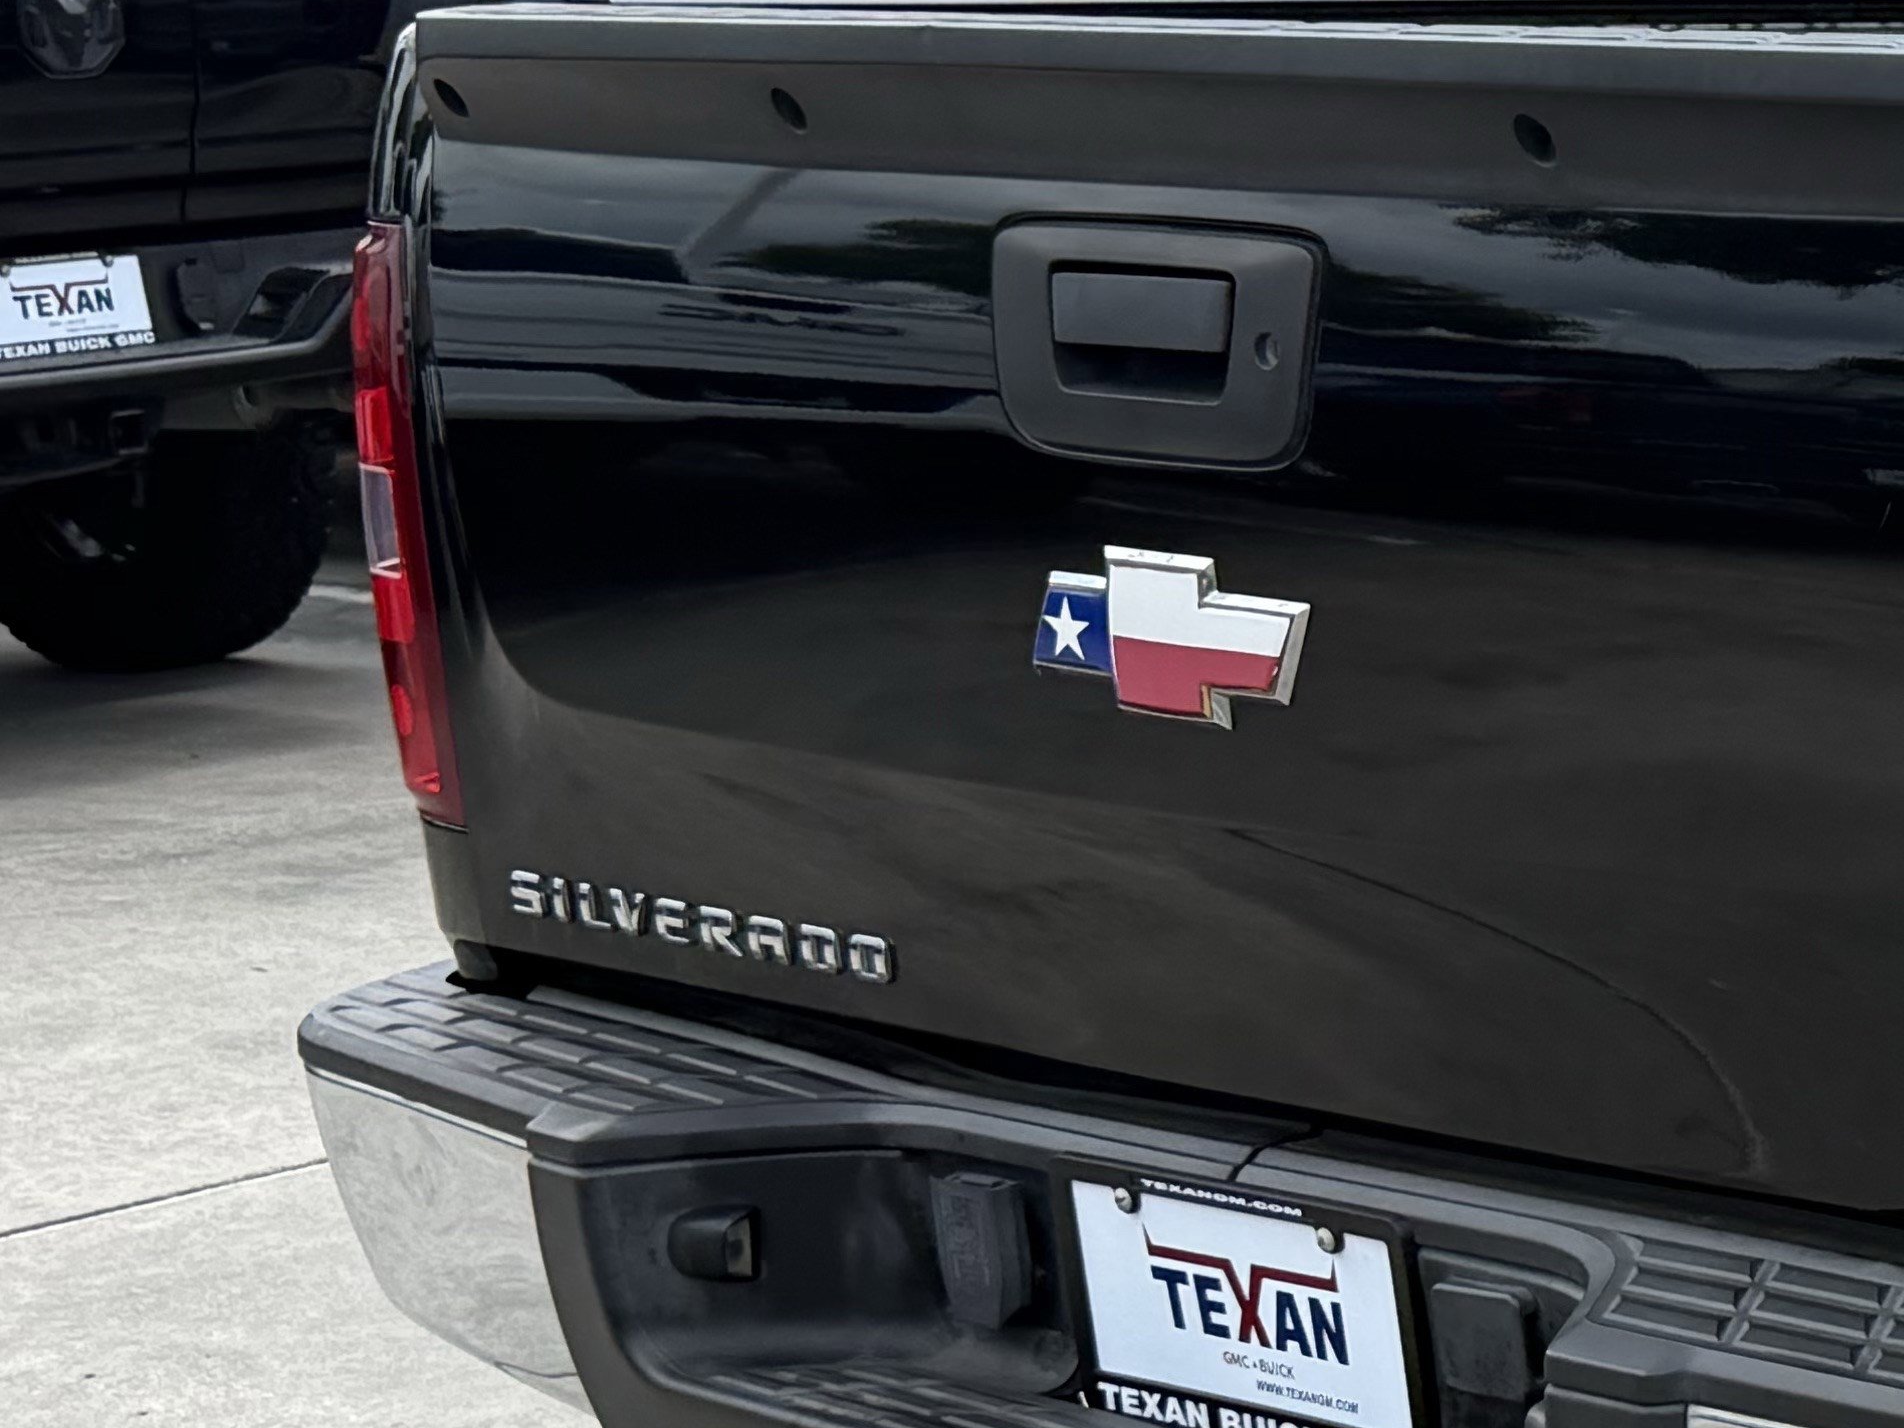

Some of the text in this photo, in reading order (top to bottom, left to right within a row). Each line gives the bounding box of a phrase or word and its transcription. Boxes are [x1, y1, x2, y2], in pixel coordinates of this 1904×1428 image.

[10, 277, 115, 320] TEXAN
[54, 336, 112, 354] BUICK
[114, 331, 156, 347] GMC
[509, 869, 897, 985] SILVERADO
[1145, 1242, 1350, 1366] TEXAN
[1222, 1351, 1296, 1380] GMC BUICK
